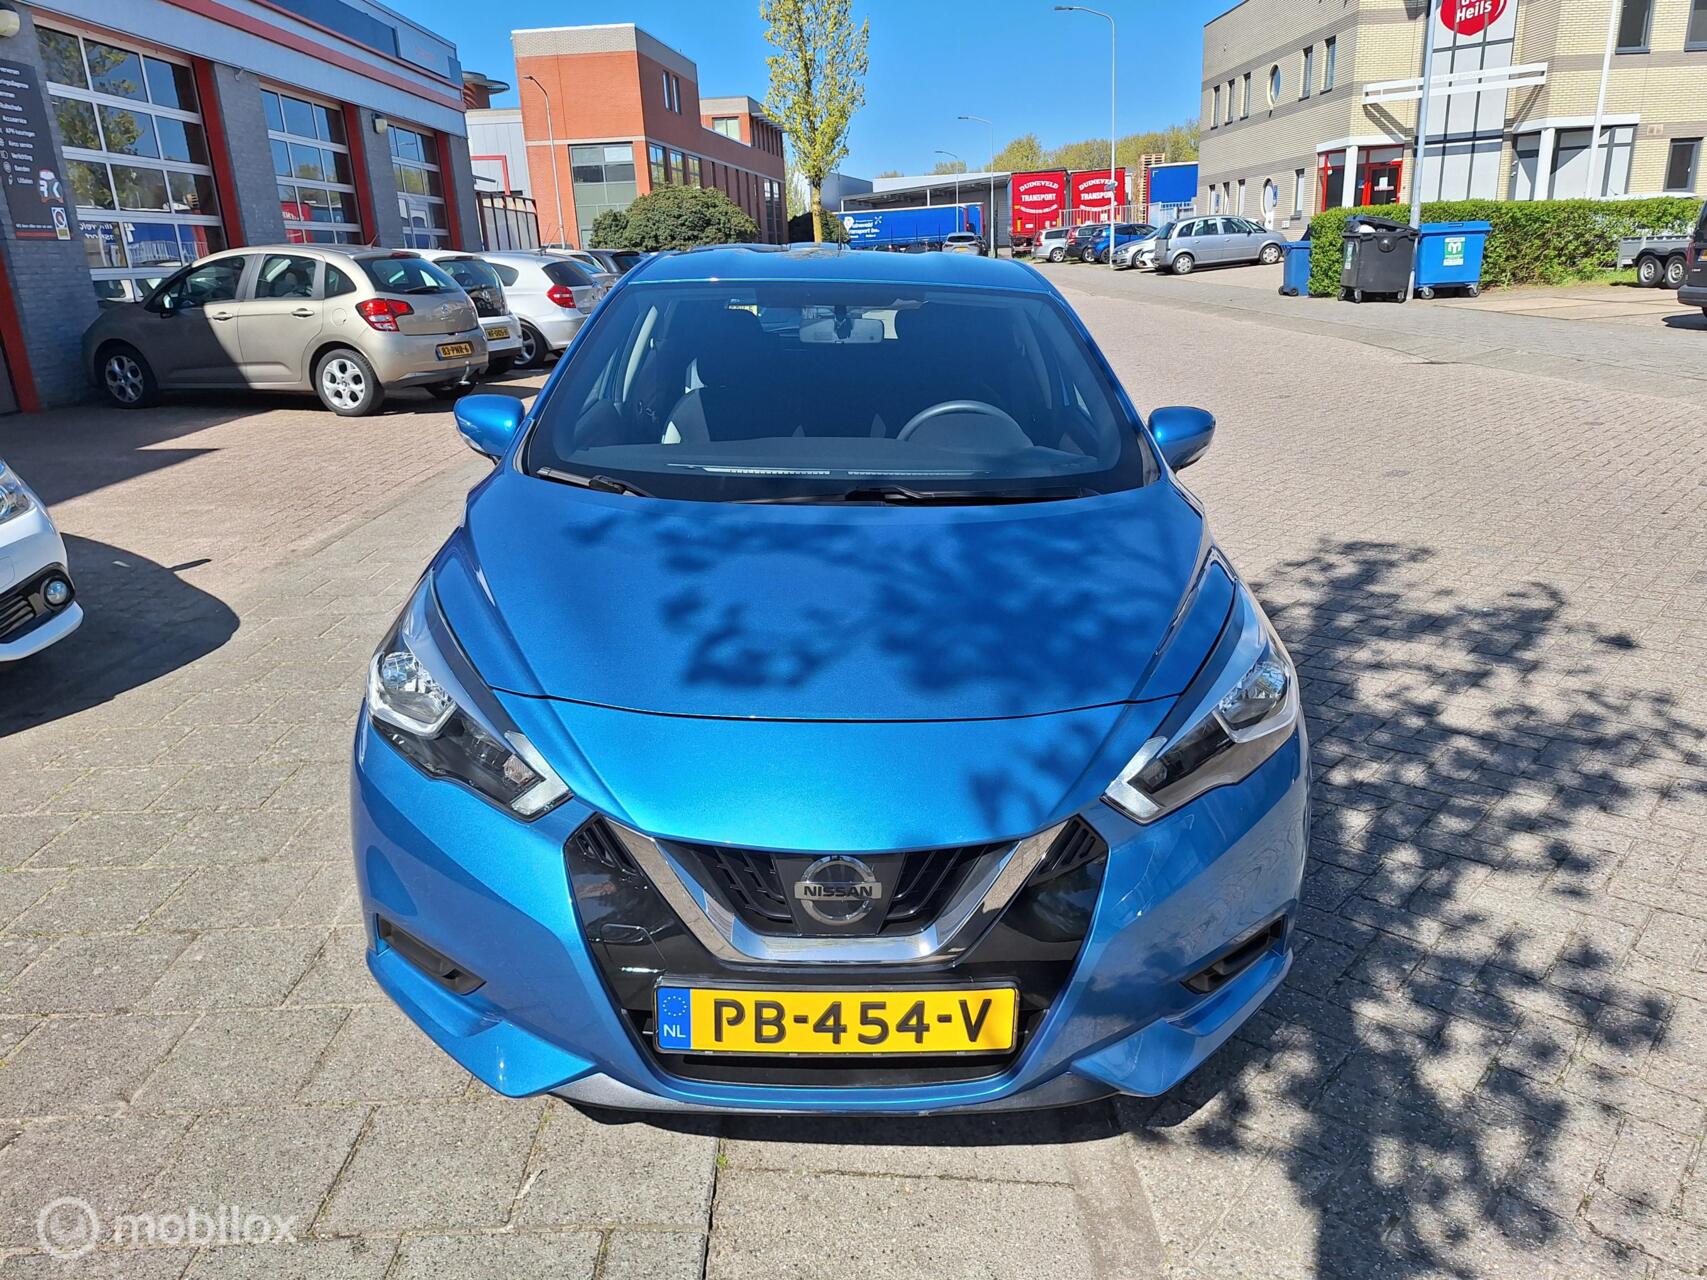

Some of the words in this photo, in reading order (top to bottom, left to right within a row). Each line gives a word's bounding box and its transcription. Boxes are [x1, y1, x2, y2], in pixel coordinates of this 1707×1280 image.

[1456, 1, 1492, 23] Heils
[1021, 193, 1056, 202] TRANSPORT
[803, 885, 874, 898] NISSAN
[713, 998, 993, 1045] PB-454-V
[664, 1023, 686, 1039] NL
